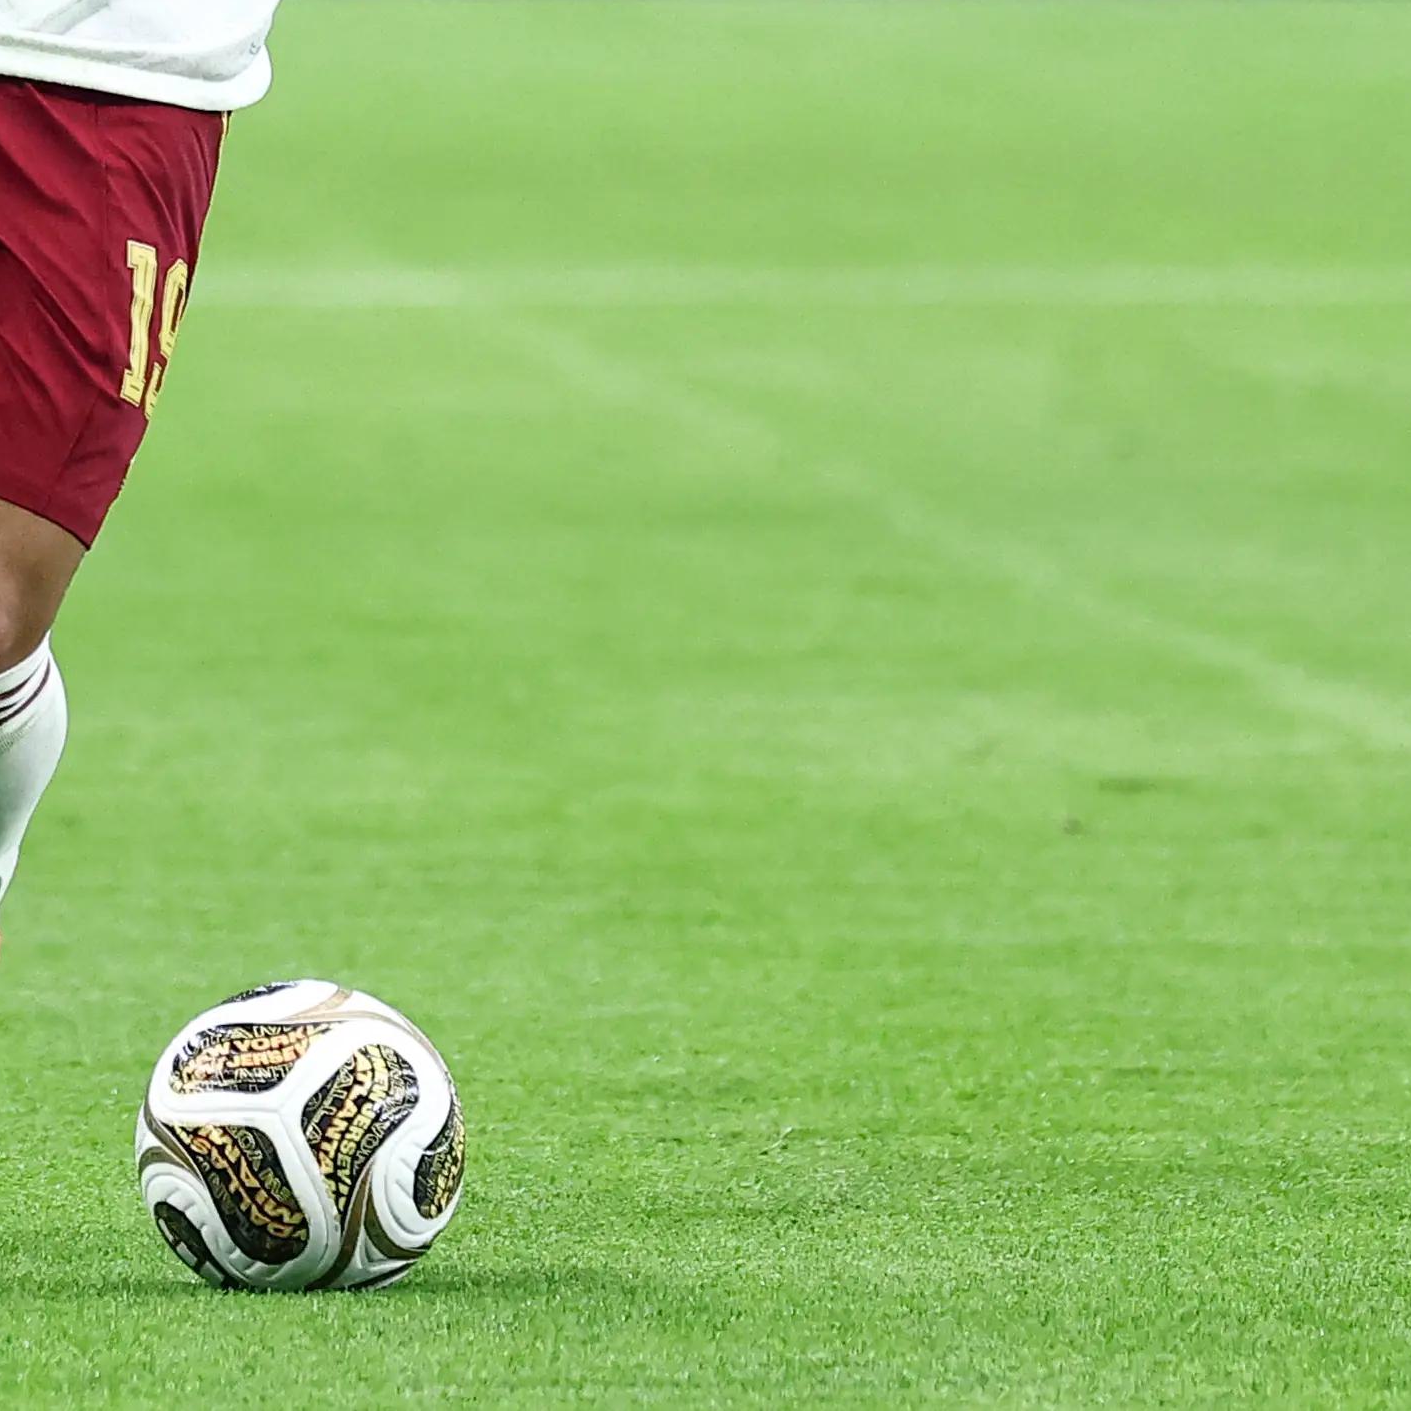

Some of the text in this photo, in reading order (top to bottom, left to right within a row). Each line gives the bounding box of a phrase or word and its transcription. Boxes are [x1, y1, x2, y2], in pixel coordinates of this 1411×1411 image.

[226, 1044, 307, 1067] JERSEY
[235, 1027, 308, 1051] YORK
[320, 1050, 371, 1175] ATLANTA
[338, 1103, 376, 1185] JERSEY
[192, 1136, 293, 1239] DALLAS
